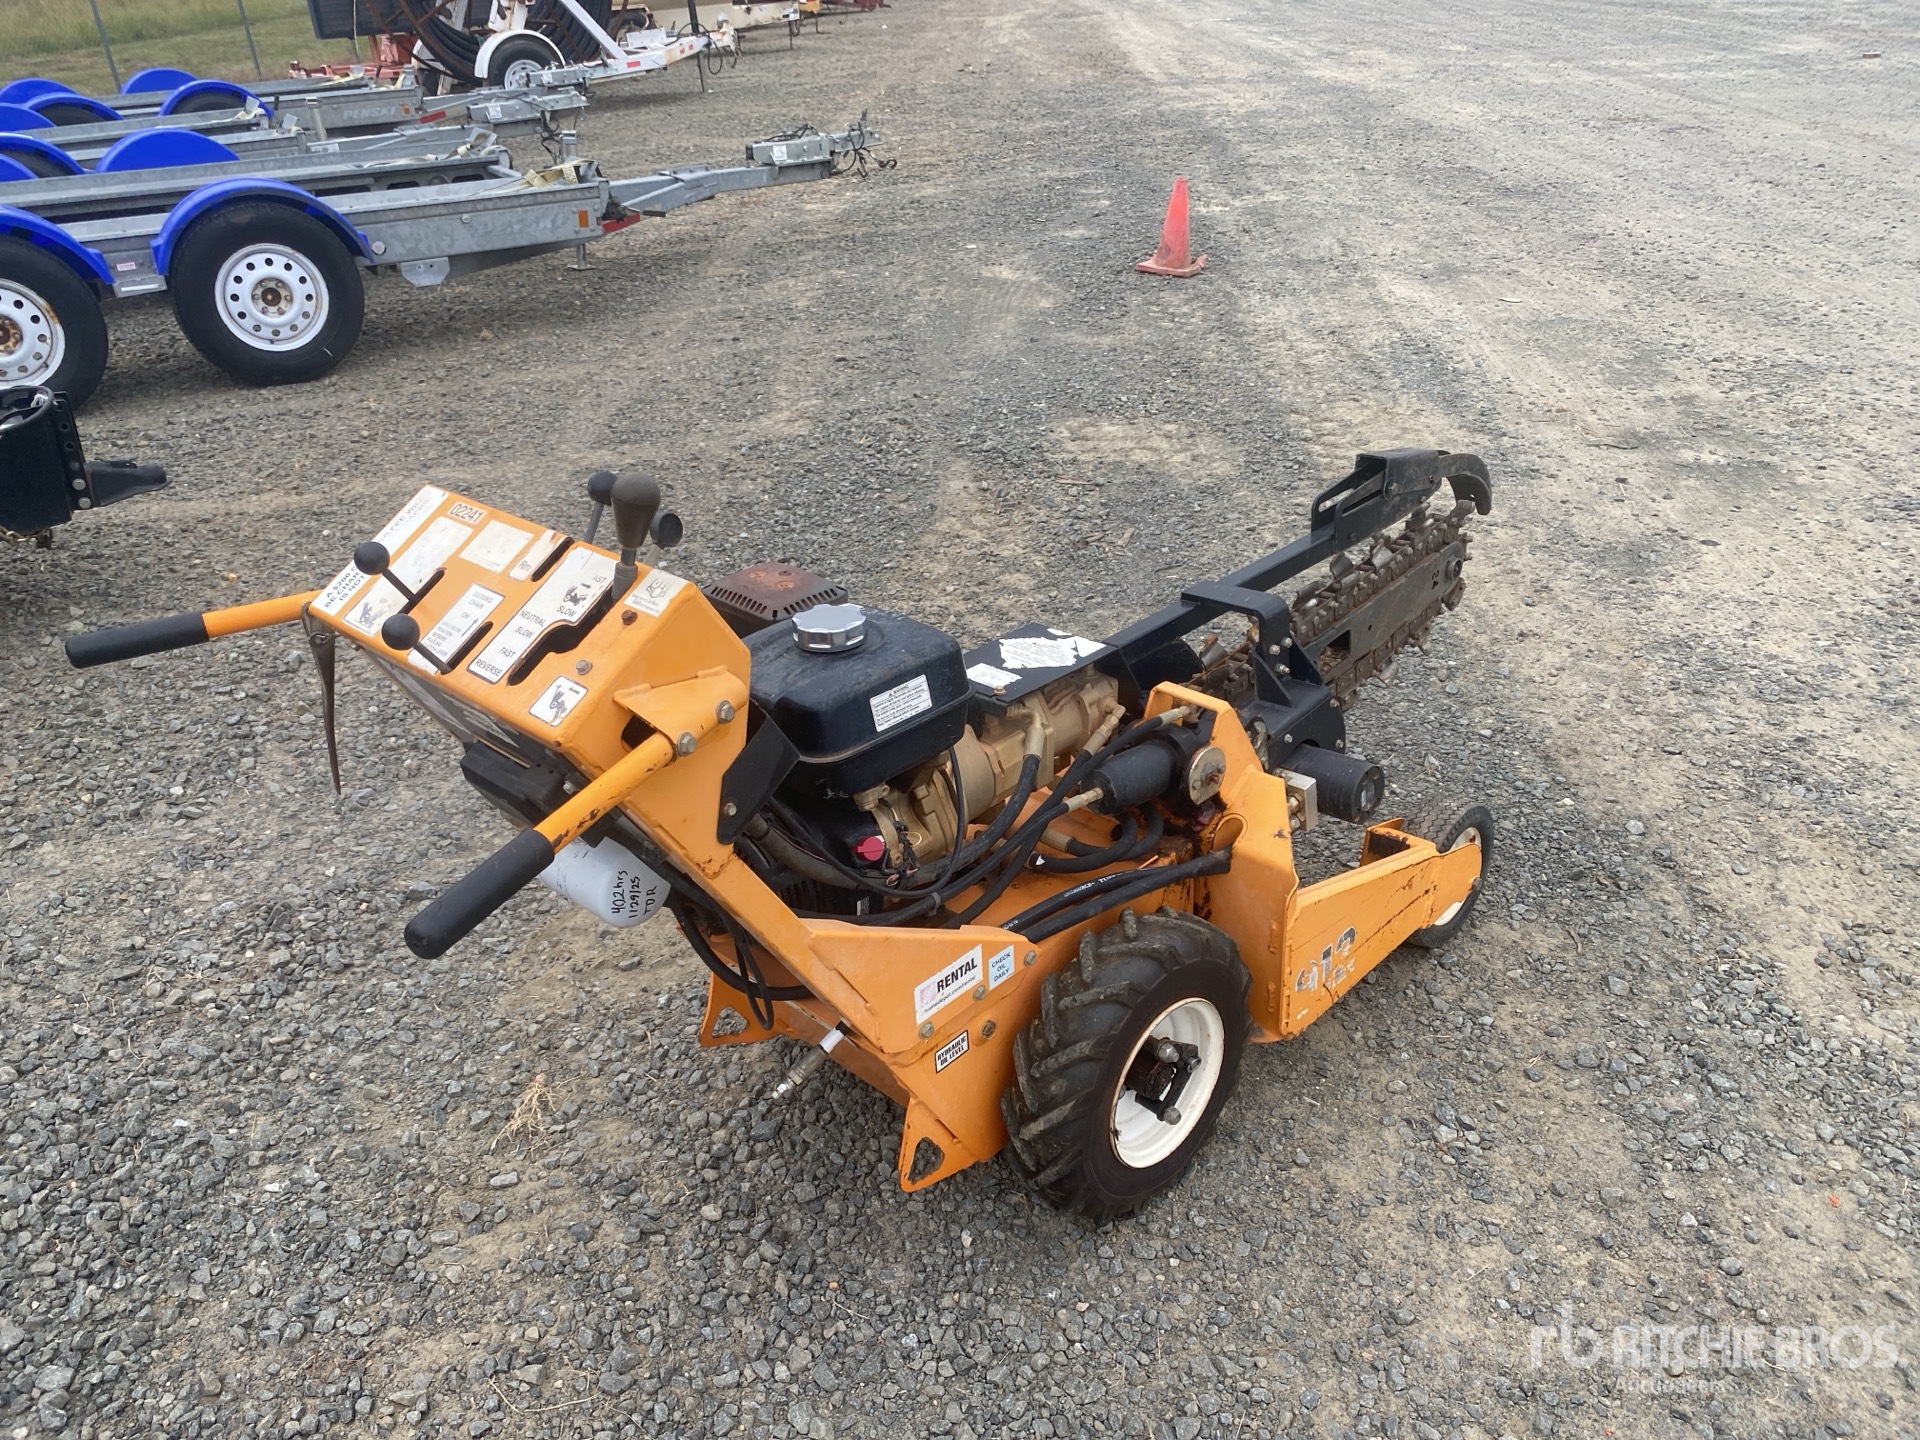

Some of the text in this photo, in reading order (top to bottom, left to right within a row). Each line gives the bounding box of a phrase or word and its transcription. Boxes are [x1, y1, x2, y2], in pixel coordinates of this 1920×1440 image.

[348, 575, 365, 592] NOT
[519, 610, 547, 627] NEUTRAL
[557, 605, 577, 618] SLOW
[515, 626, 535, 639] SLOW
[499, 647, 516, 658] FAST
[474, 658, 503, 677] REVERSE
[991, 951, 1011, 968] CHECK
[996, 963, 1006, 972] OIL
[936, 957, 978, 994] RENTAL
[993, 967, 1010, 982] DAILY
[937, 1035, 967, 1062] HYDRAULIC
